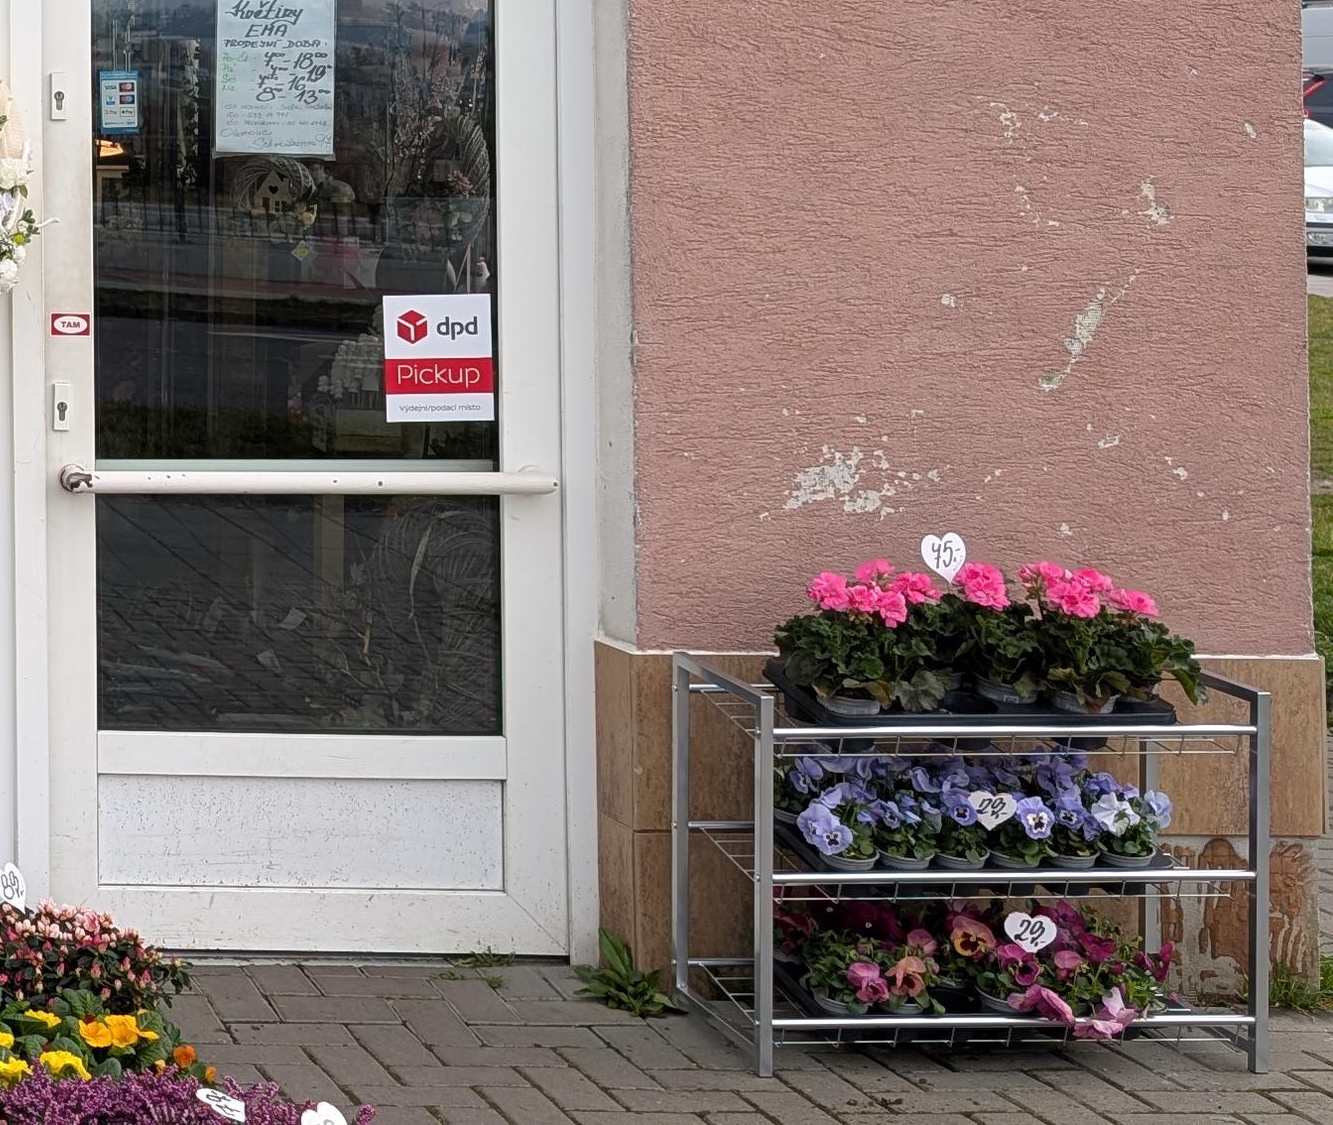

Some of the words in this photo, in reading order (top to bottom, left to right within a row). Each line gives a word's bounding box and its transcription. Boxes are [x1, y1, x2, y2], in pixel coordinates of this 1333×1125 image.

[436, 316, 479, 341] dpd
[397, 363, 481, 388] Pickup
[399, 404, 457, 413] Výdejní/podací
[458, 403, 481, 411] místo
